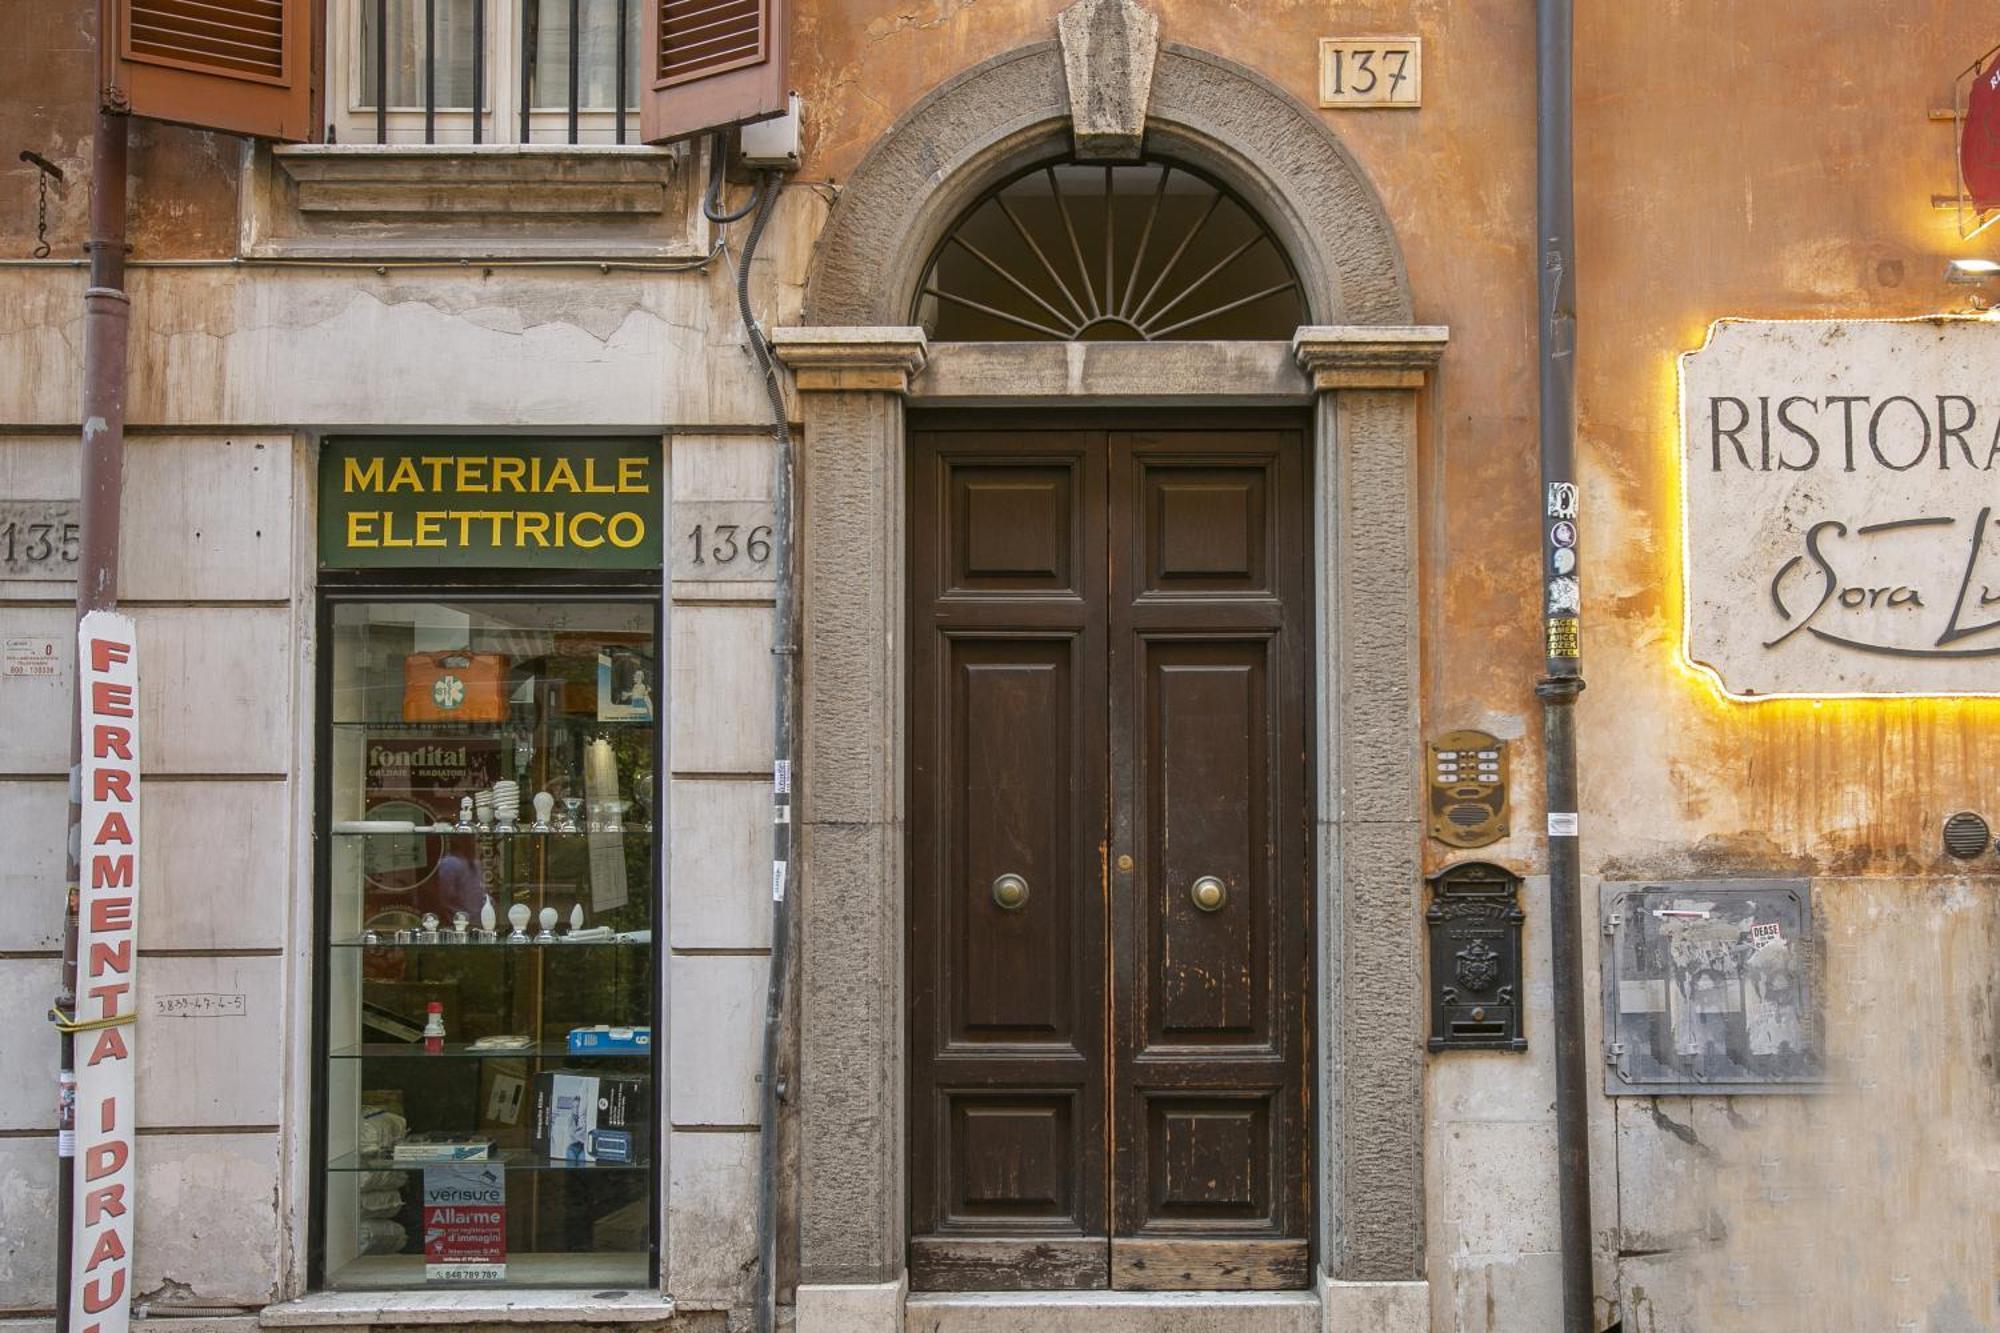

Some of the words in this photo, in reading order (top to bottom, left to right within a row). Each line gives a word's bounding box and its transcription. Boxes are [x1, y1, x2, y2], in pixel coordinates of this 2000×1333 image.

[1332, 50, 1410, 103] 137
[343, 456, 649, 494] MATERIALE
[1, 522, 80, 563] 135
[346, 510, 646, 548] ELETTRICO
[688, 524, 773, 564] 136
[1762, 519, 1926, 650] Sora
[370, 745, 467, 767] fondital
[86, 638, 134, 1067] FERRAMENTA
[82, 1096, 129, 1333] IDRAU
[430, 1189, 500, 1201] verisure
[431, 1207, 501, 1225] Allarme
[464, 1271, 479, 1280] 789
[482, 1271, 498, 1280] 789
